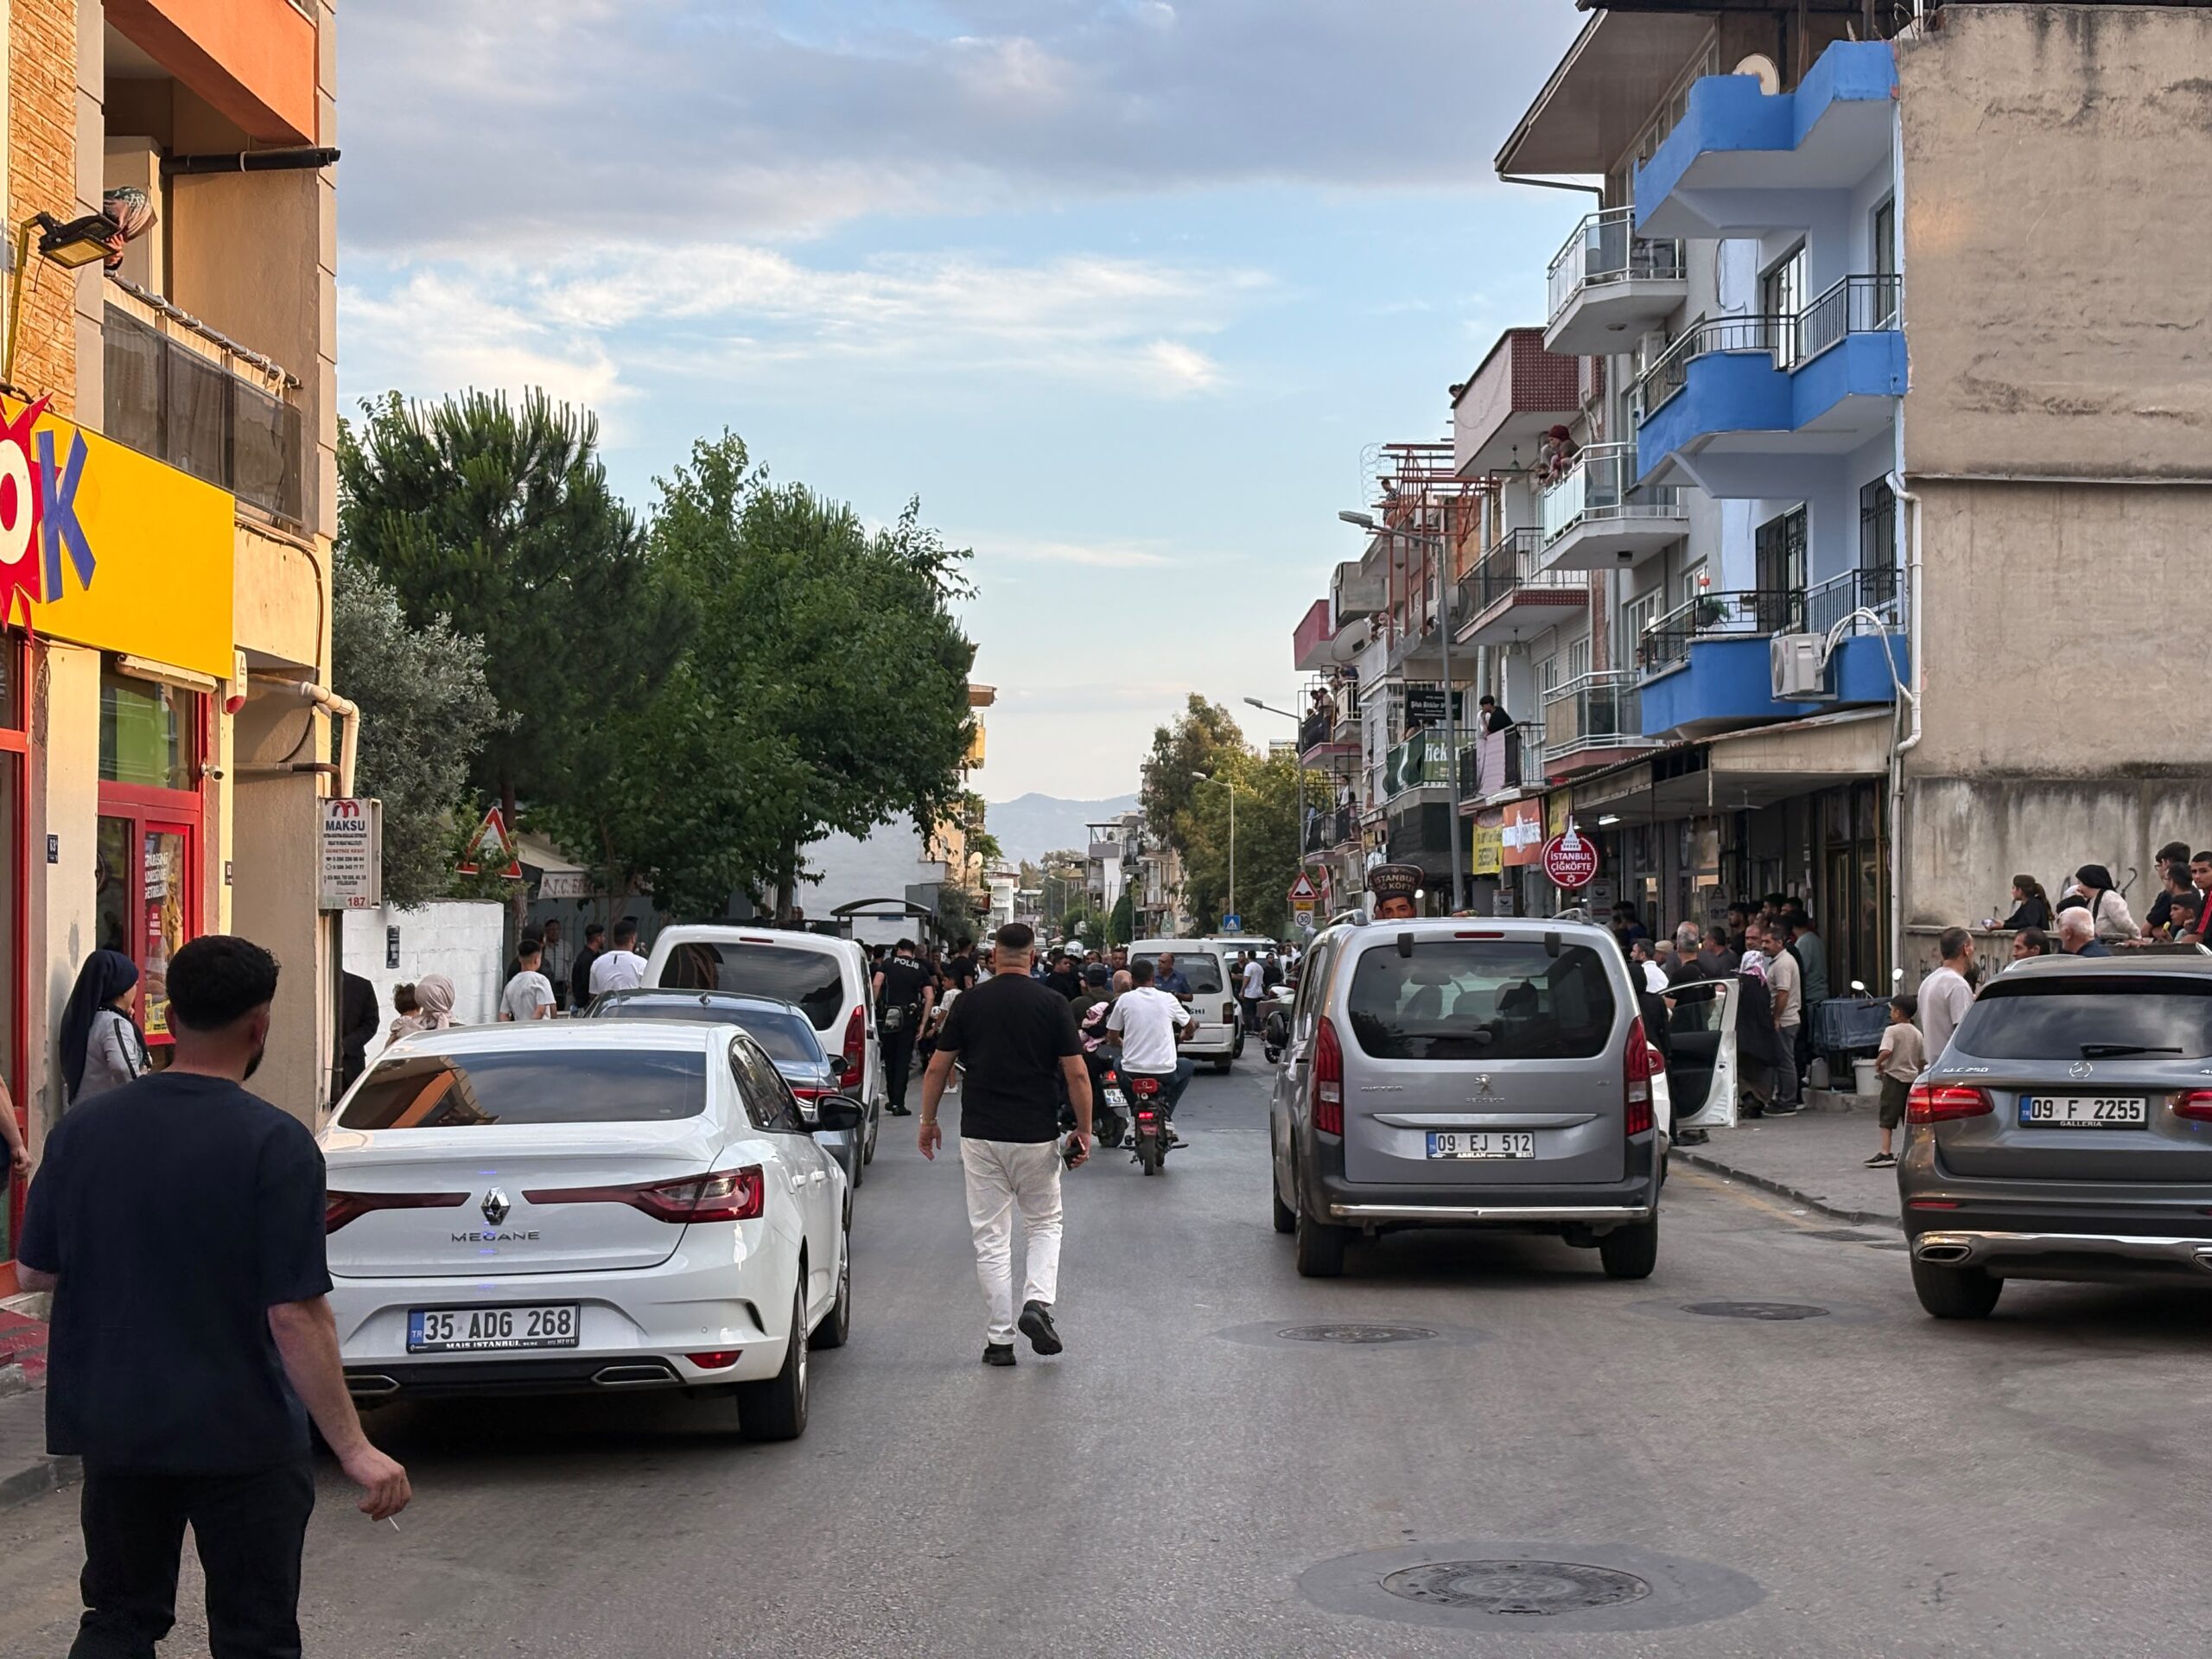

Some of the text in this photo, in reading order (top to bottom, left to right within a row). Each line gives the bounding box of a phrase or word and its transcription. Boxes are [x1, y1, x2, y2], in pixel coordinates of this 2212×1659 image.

[325, 820, 365, 831] MAKSU
[1550, 850, 1592, 861] İSTANBUL
[1550, 861, 1592, 873] ÇİĞKÖFTE
[347, 897, 365, 906] 187
[2031, 1099, 2054, 1119] 09
[2068, 1099, 2080, 1120] F
[2093, 1099, 2140, 1120] 2255
[1437, 1135, 1456, 1152] 09
[1470, 1135, 1488, 1152] EJ
[1502, 1134, 1530, 1152] 512
[411, 1308, 572, 1341] TR 35 ADG 268
